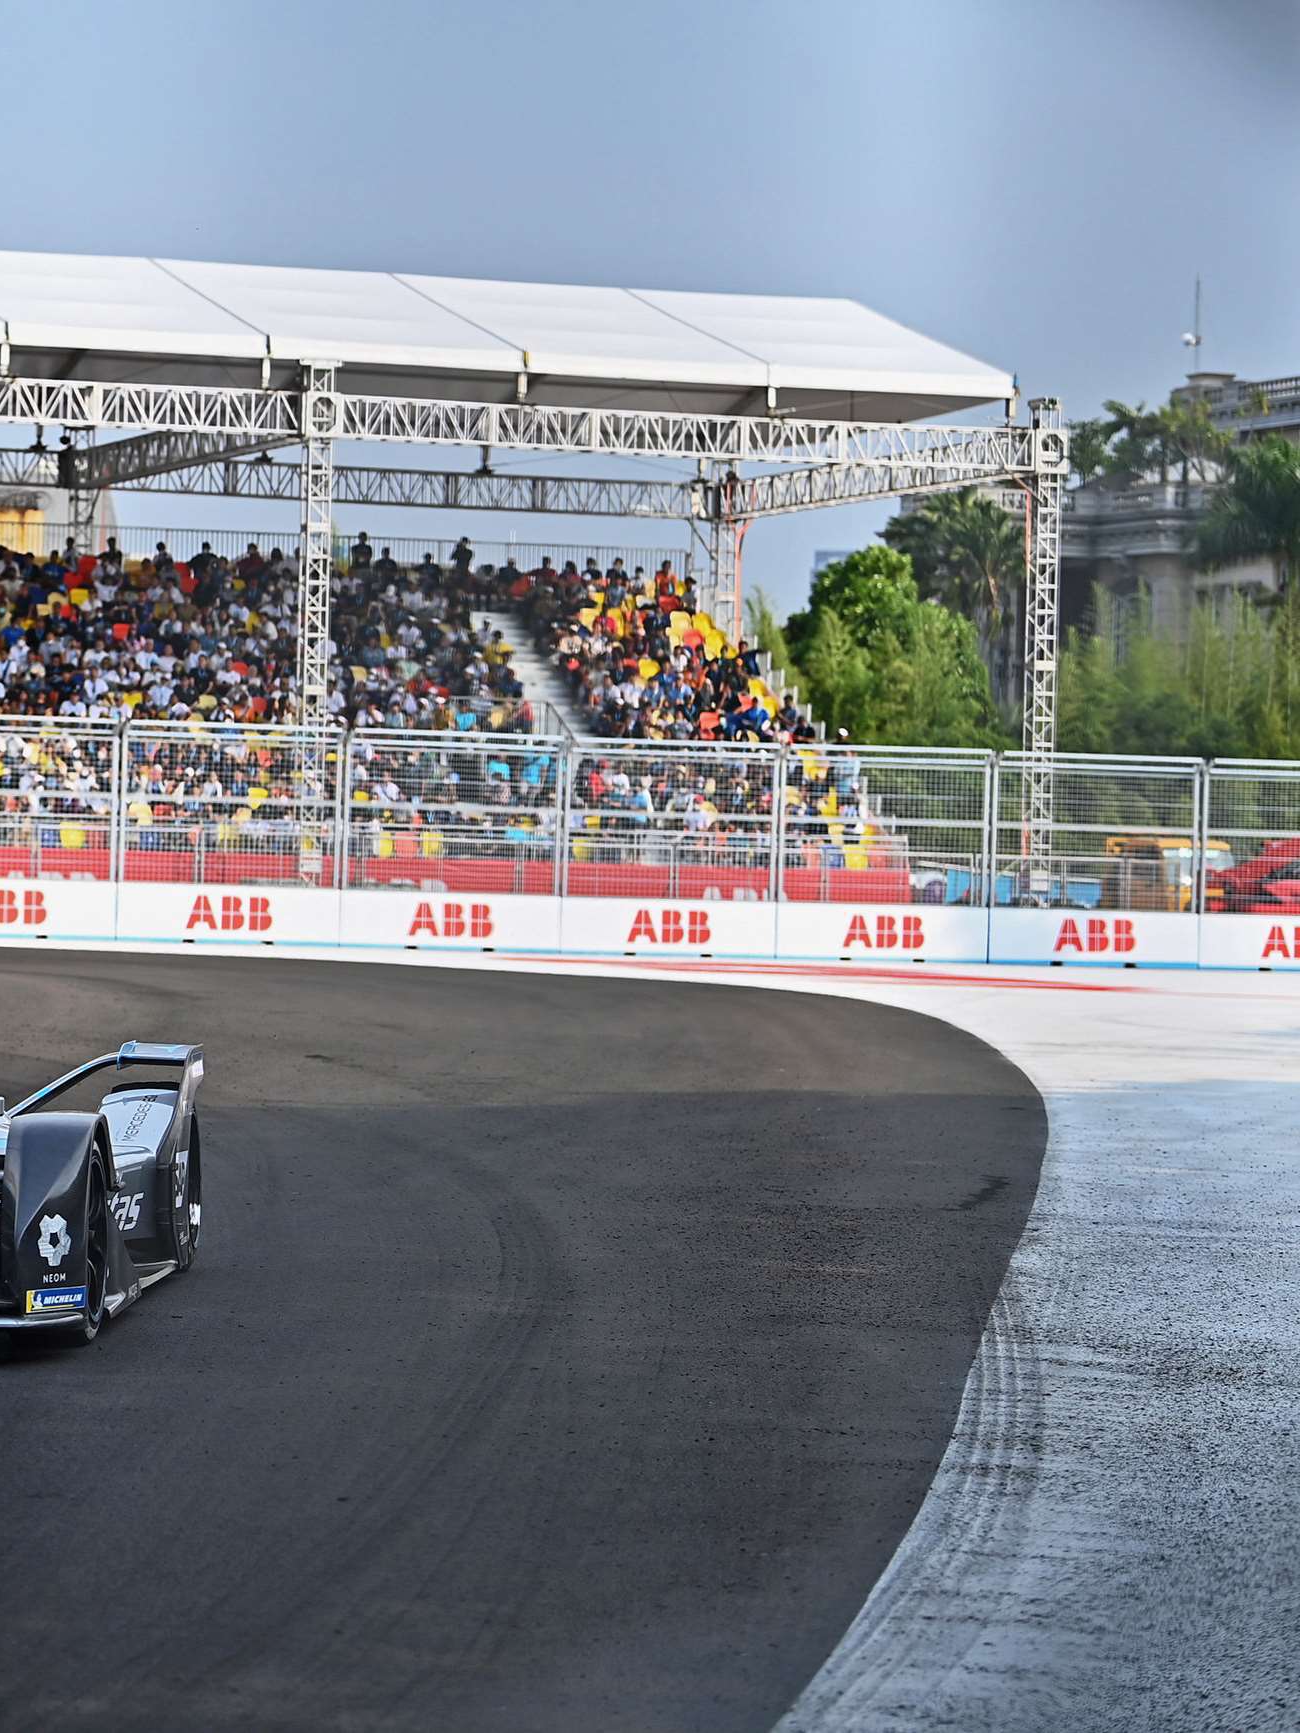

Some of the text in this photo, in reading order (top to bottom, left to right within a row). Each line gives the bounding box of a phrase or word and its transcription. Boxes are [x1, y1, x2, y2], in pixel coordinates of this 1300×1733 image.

[186, 896, 273, 932] ABB
[409, 902, 494, 938] ABB
[627, 909, 712, 944] ABB
[843, 915, 925, 950] ABB
[1055, 918, 1137, 953] ABB
[42, 1272, 67, 1284] NEOM
[43, 1293, 83, 1305] MICHELIN
